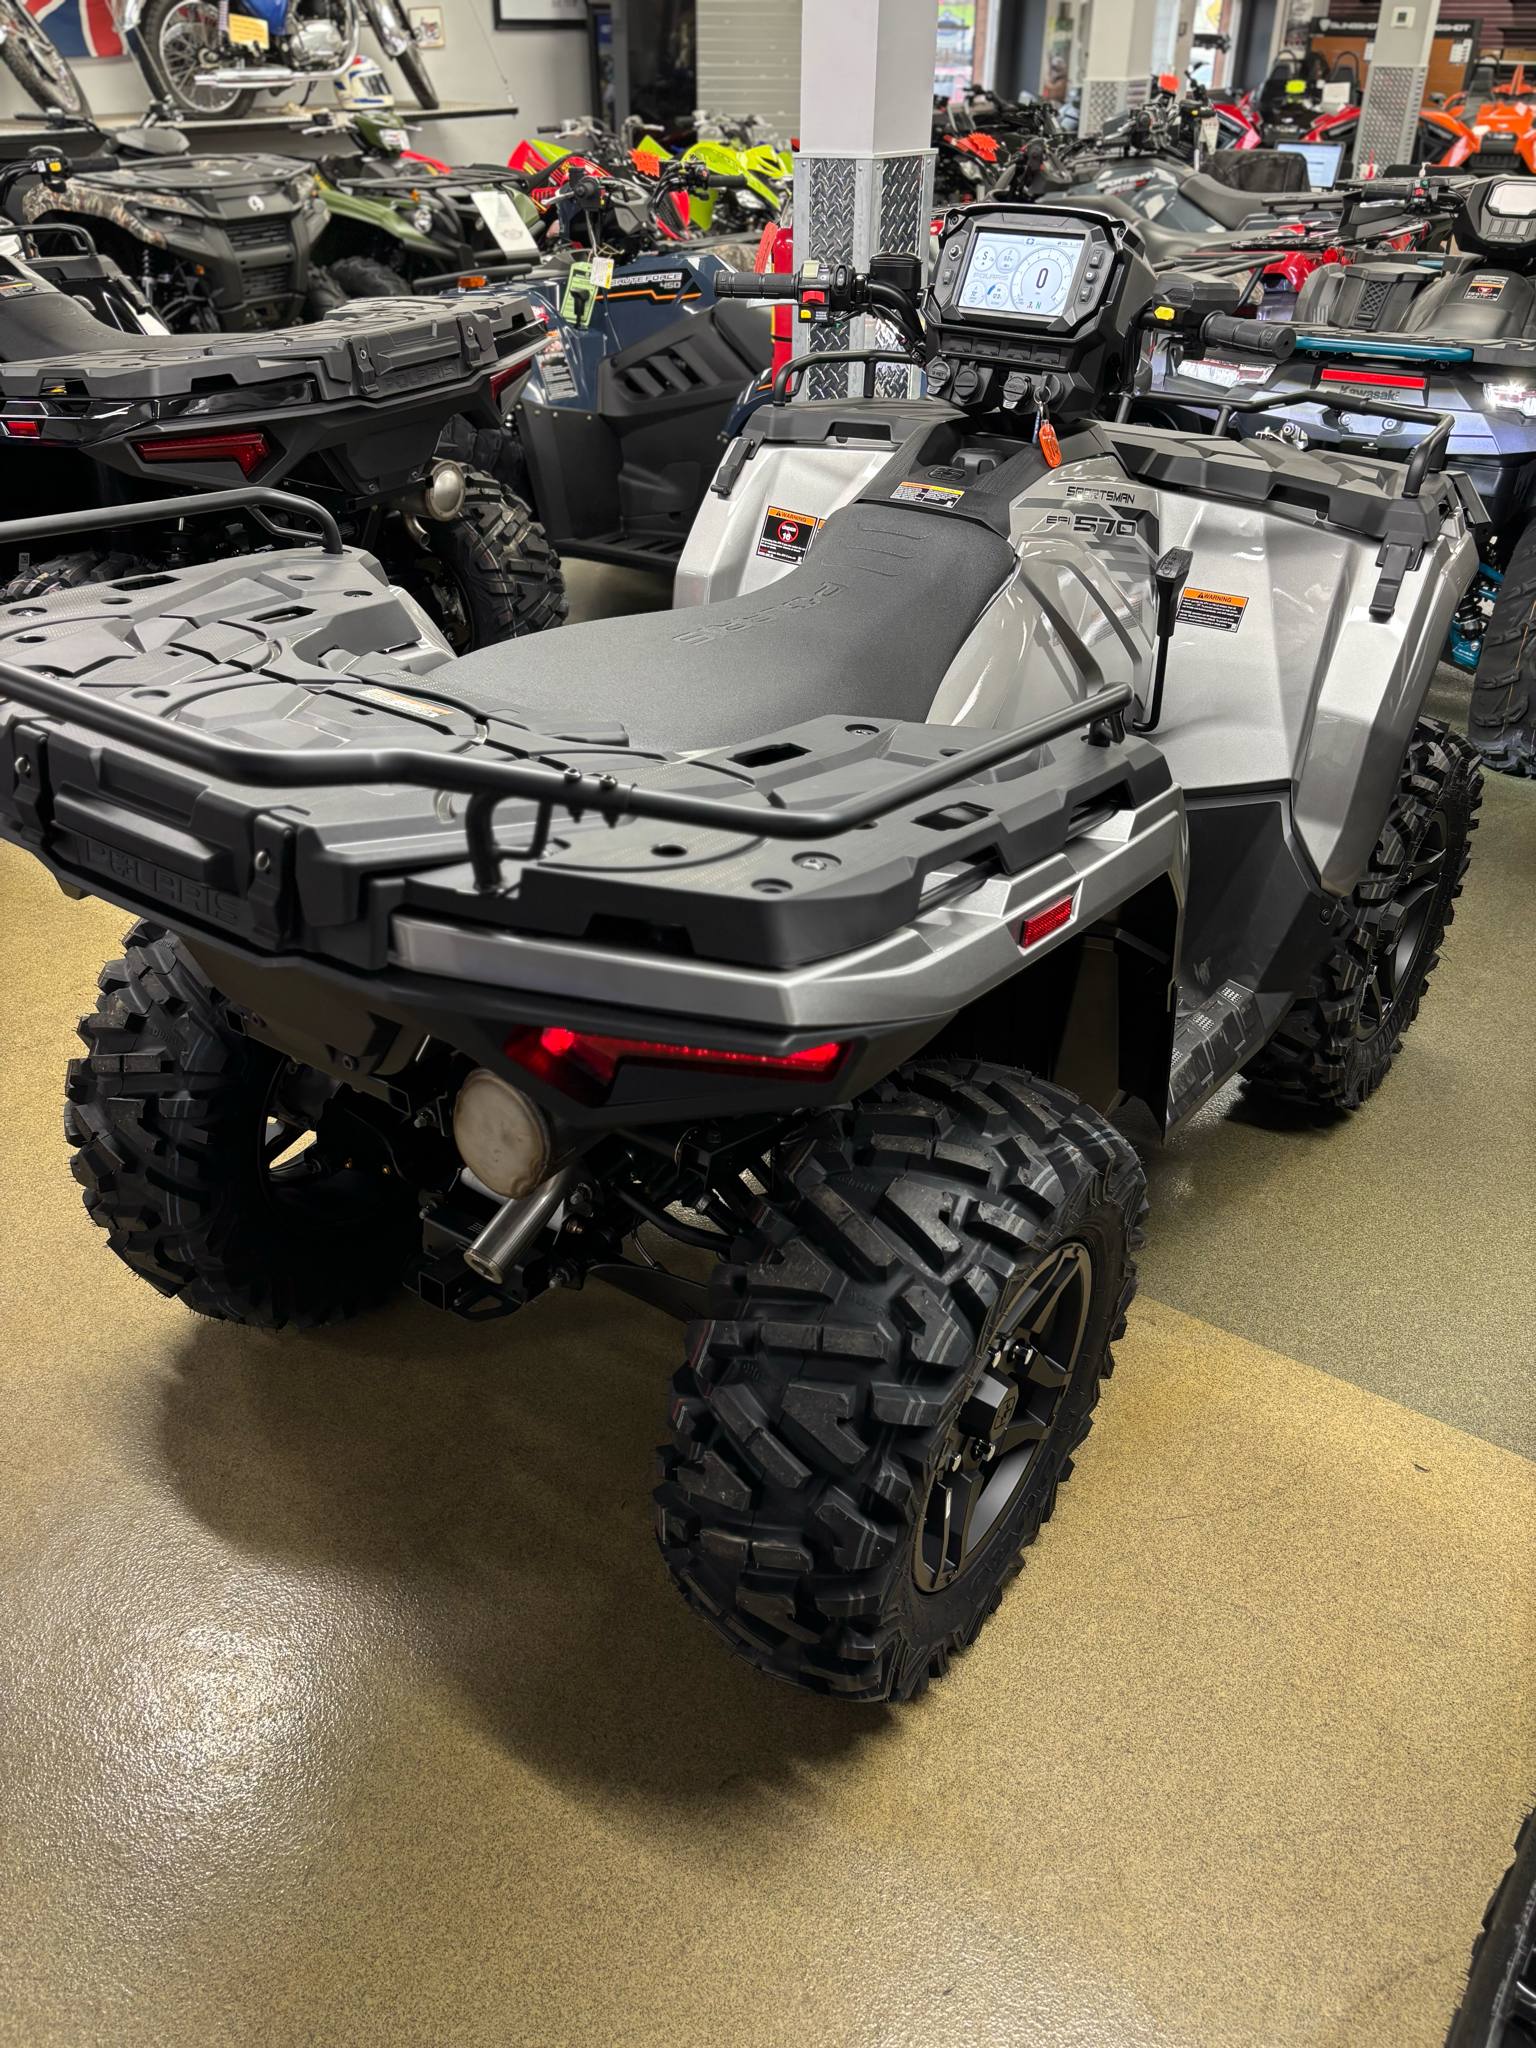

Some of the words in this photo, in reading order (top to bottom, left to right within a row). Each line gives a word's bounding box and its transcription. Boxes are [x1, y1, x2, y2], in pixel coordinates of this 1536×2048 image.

[659, 281, 681, 289] 450
[1036, 267, 1049, 289] 0
[1341, 384, 1400, 401] Kawasaki
[1066, 486, 1135, 504] SPORTSMAN
[781, 512, 807, 523] WARNING
[1073, 514, 1137, 536] 570
[1204, 592, 1232, 603] WARNING
[86, 838, 241, 926] POLARIS
